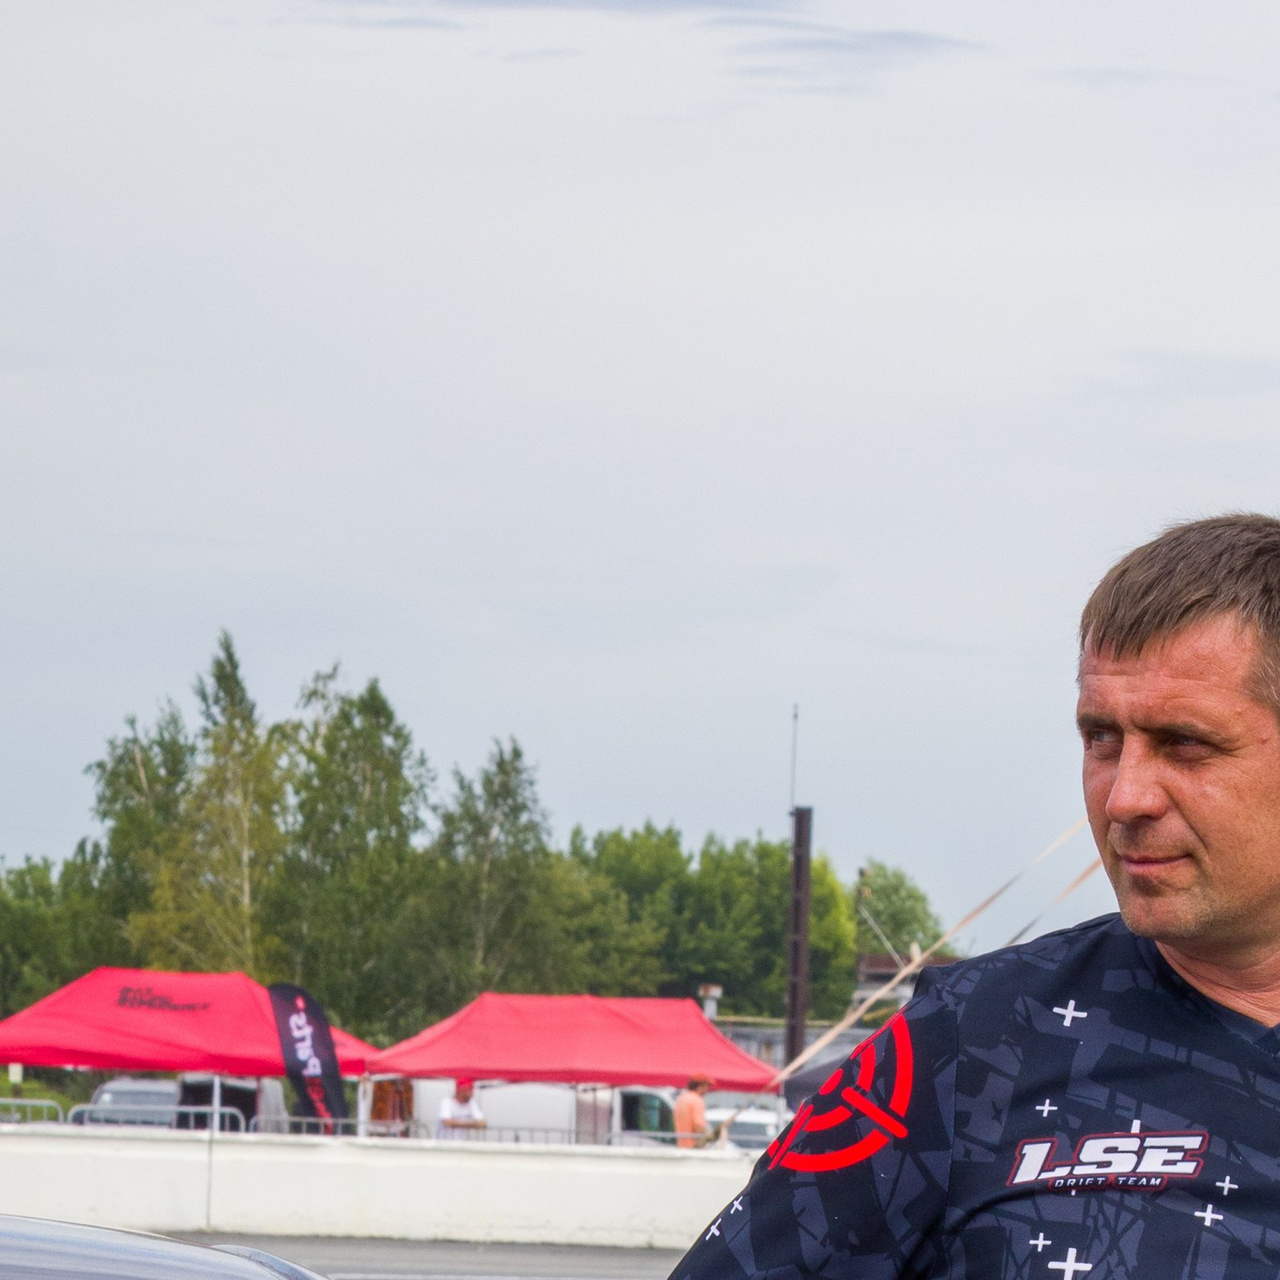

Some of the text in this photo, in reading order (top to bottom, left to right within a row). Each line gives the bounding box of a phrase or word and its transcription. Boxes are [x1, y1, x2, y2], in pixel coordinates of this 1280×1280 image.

[1013, 1136, 1203, 1184] LSE
[1055, 1176, 1162, 1188] DRIFT TEAM
